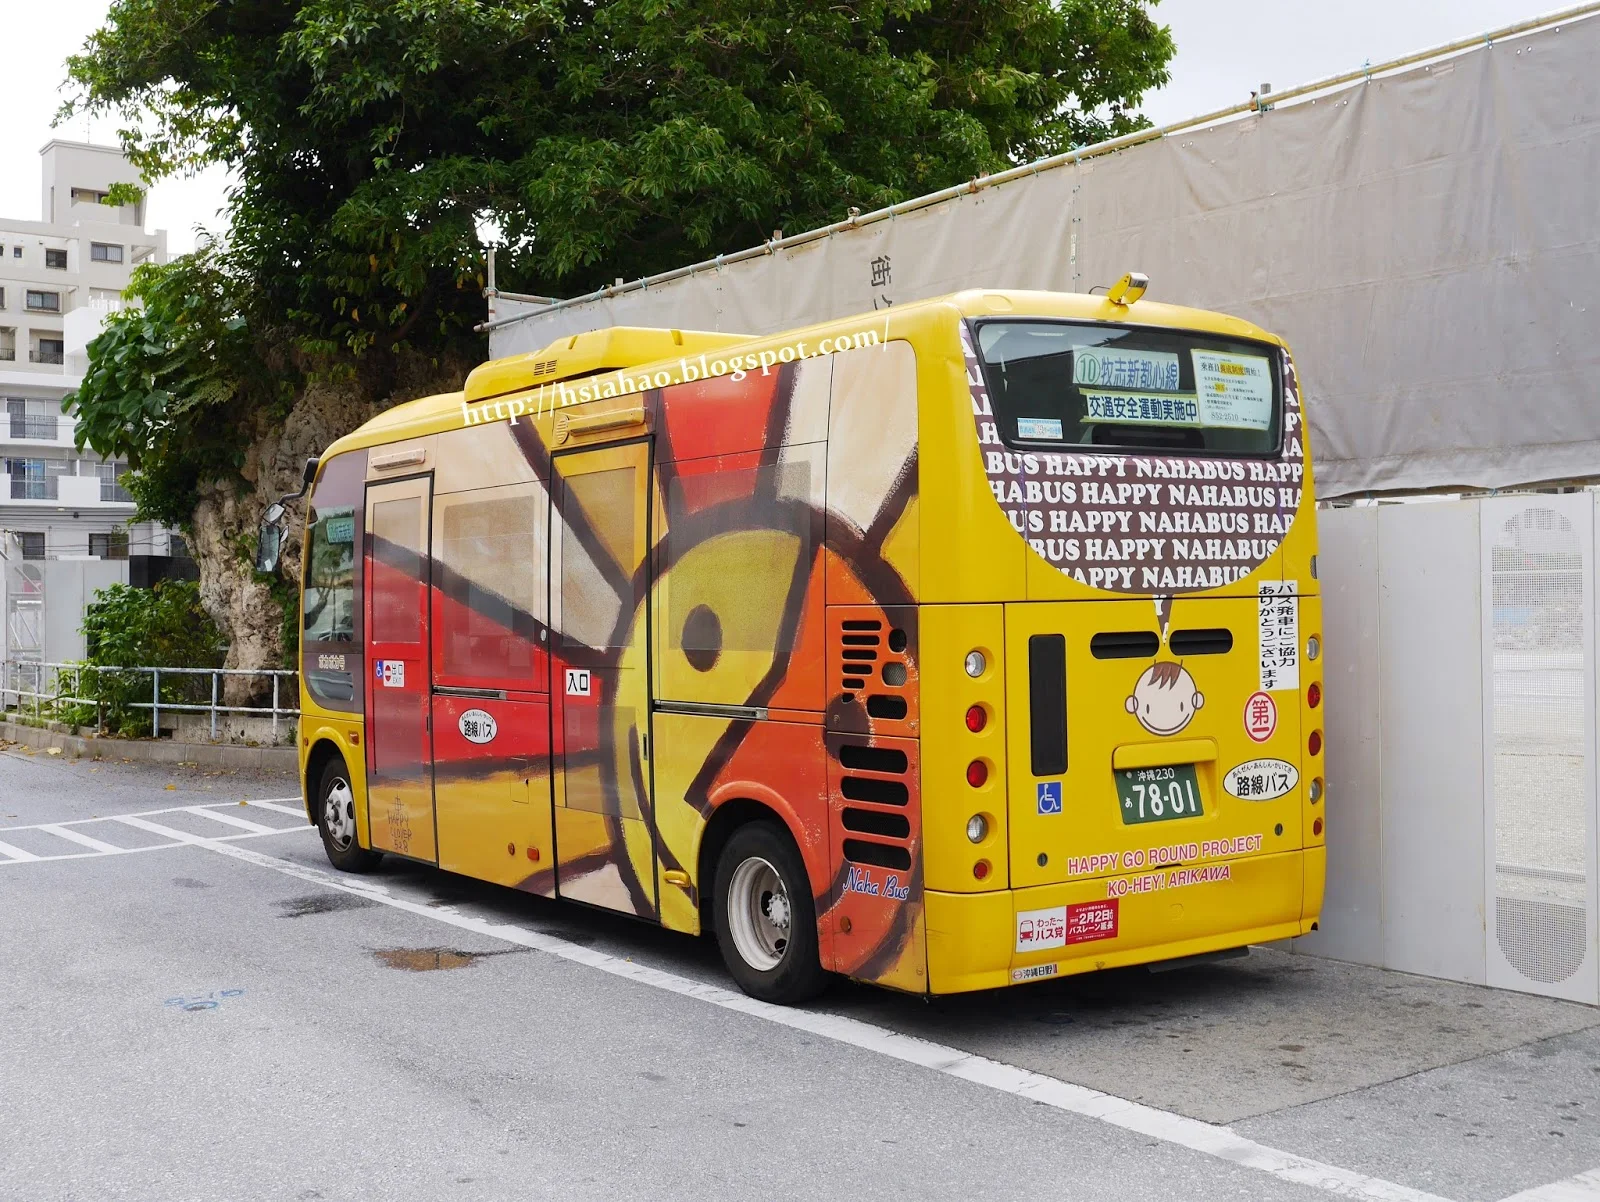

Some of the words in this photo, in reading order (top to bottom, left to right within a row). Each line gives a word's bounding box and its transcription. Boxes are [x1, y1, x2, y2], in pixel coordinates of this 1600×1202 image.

[1089, 395, 1197, 421] 交通安全運動実施中
[1043, 455, 1126, 477] HAPPY
[1132, 458, 1245, 480] NAHABUS
[1081, 482, 1162, 505] HAPPY
[1168, 484, 1275, 507] NAHABUS
[1049, 510, 1133, 533] HAPPY
[1139, 512, 1249, 533] NAHABUS
[1085, 539, 1166, 560] HAPPY
[1172, 539, 1279, 560] NAHABUS
[1056, 567, 1136, 589] APPY
[1259, 585, 1278, 690] ありがとうございます
[1277, 583, 1296, 667] バス発車にご協力
[567, 672, 589, 692] 入口
[464, 719, 493, 738] 路線バス
[1236, 772, 1289, 797] 路線バス
[1132, 779, 1196, 818] 78-01
[1068, 853, 1119, 875] HAPPY
[1123, 849, 1145, 867] GO
[1149, 843, 1198, 865] ROUND
[1202, 834, 1263, 858] PROJECT
[842, 867, 879, 896] Naha
[881, 874, 910, 900] Bus
[1107, 874, 1165, 897] KO-HEY!
[1168, 865, 1231, 888] ARIKAWA
[1036, 926, 1064, 941] バス党
